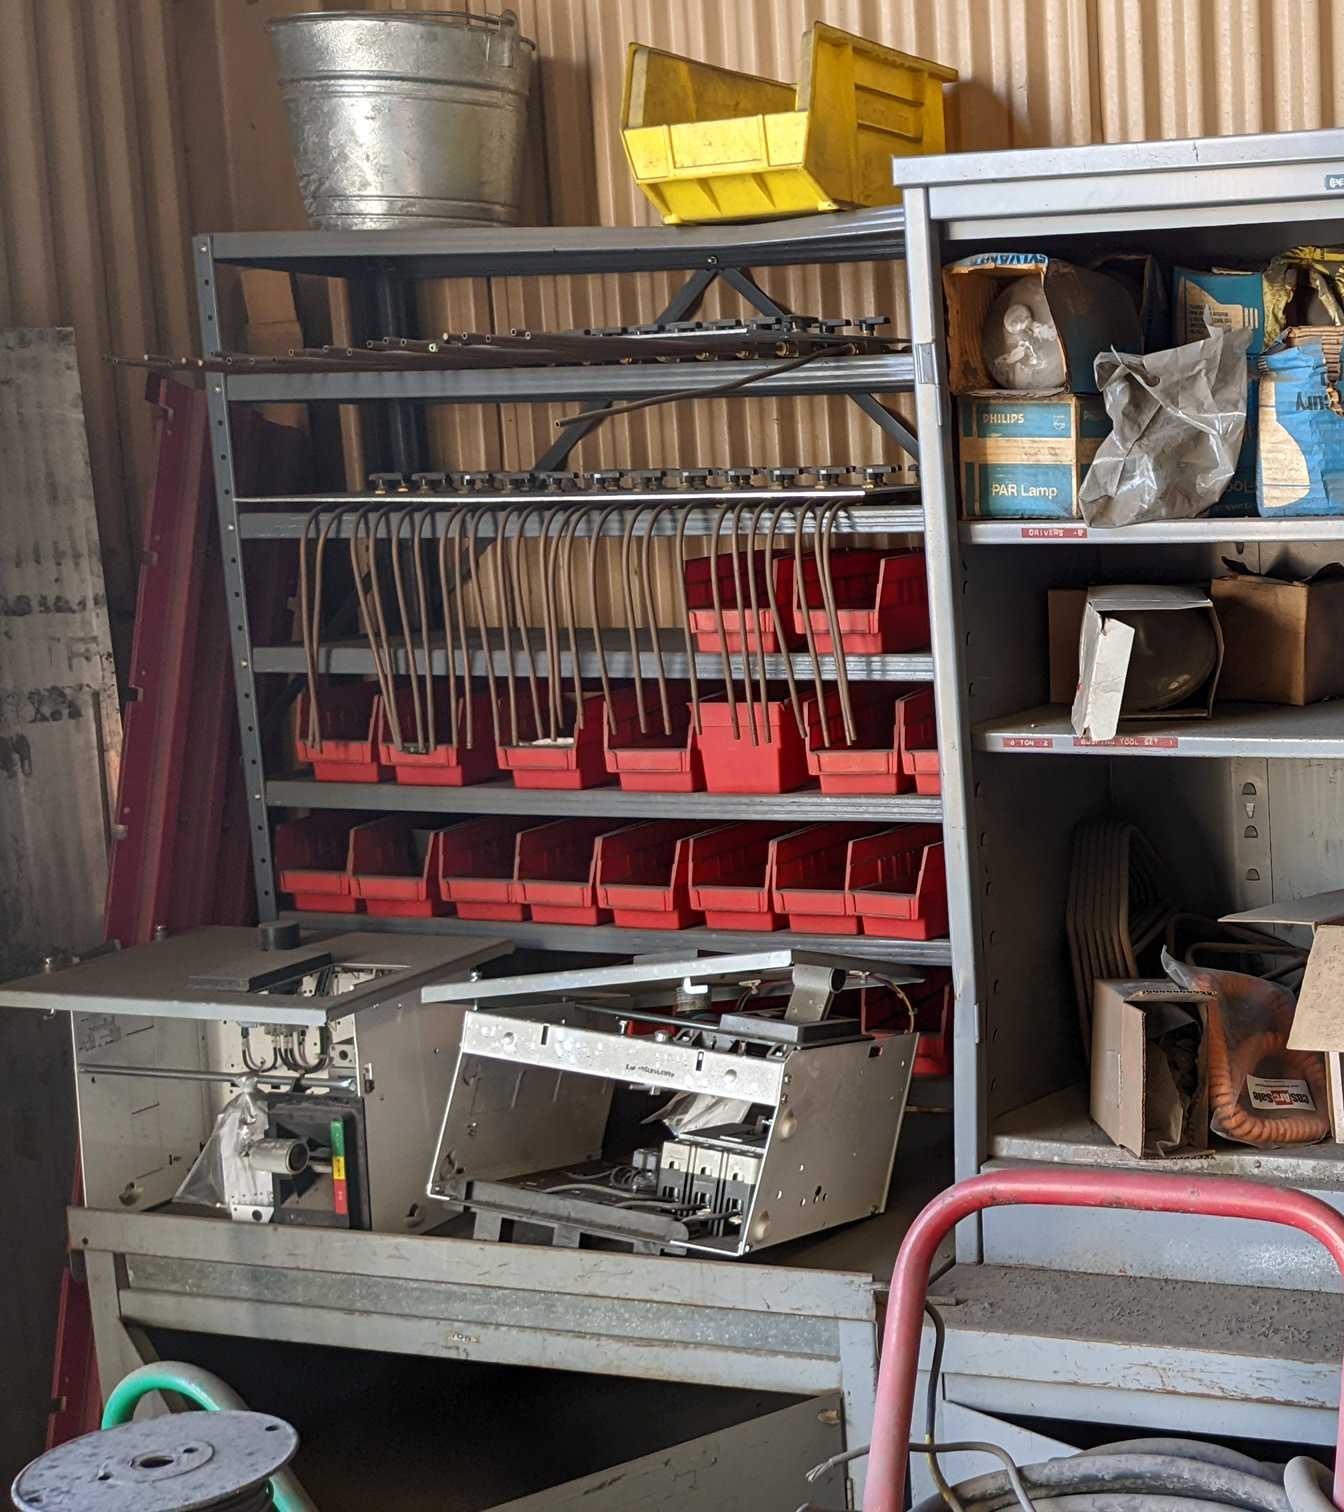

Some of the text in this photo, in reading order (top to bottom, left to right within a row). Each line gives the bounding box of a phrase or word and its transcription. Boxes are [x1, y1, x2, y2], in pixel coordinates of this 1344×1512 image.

[983, 413, 1025, 424] PHILIPS
[992, 483, 1058, 500] PAR Lamp
[1120, 738, 1138, 746] TOOL
